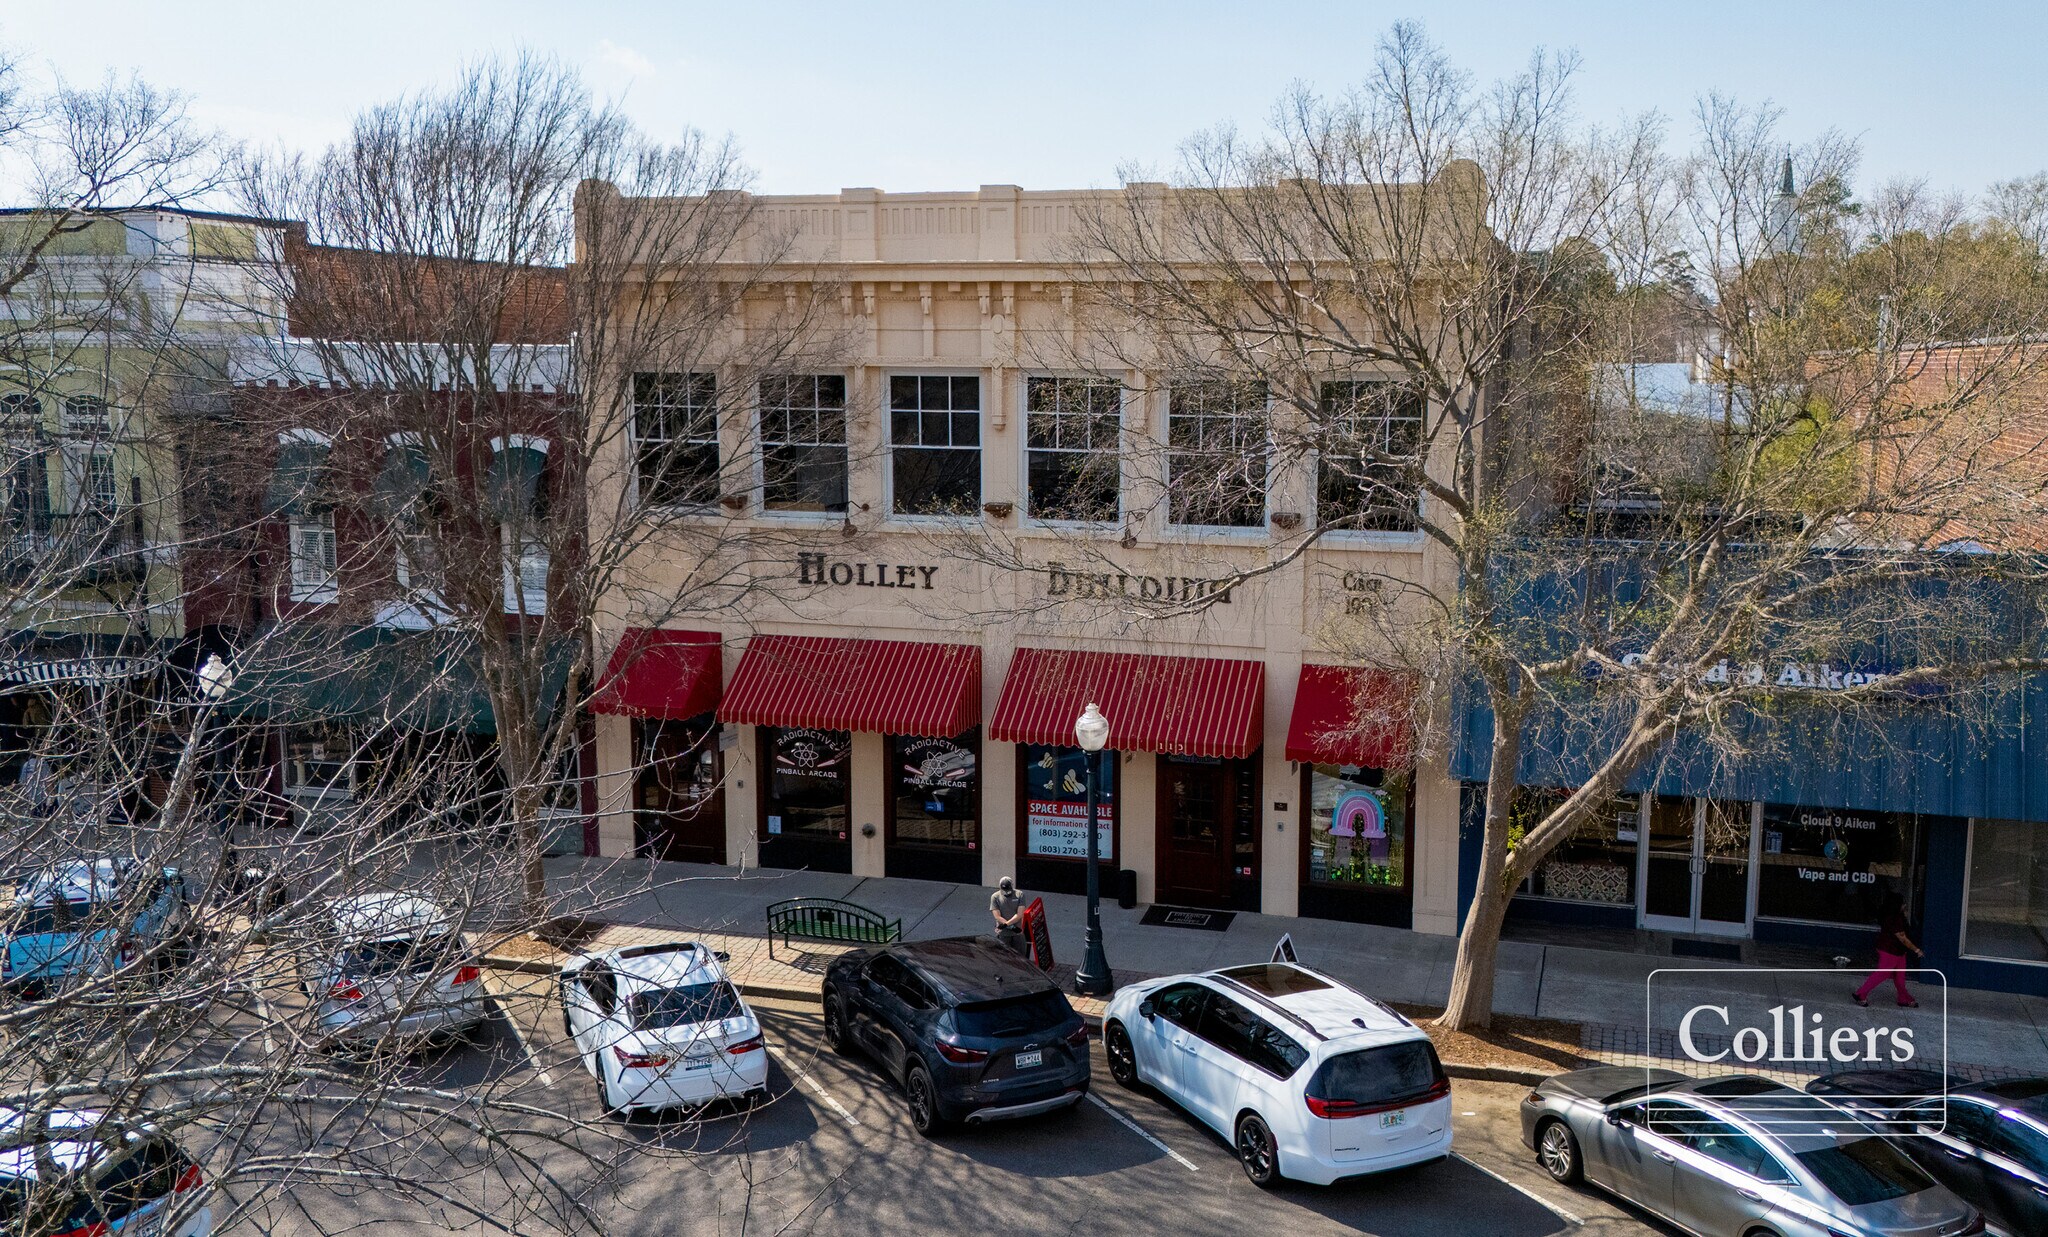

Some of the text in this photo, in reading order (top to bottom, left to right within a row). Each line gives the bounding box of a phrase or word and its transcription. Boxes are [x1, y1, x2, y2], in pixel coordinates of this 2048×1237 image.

[798, 552, 938, 590] HOLLEY
[776, 730, 837, 750] RADIOACTIVE
[904, 738, 966, 760] RADIOACTIVE
[776, 768, 838, 778] PINBALL ARCADE
[903, 777, 967, 788] PINBALL ARCADE
[1030, 803, 1112, 817] SPACE AVAILBLE
[1043, 819, 1084, 829] information
[1800, 814, 1876, 830] Cloud 9 Aiken
[1039, 828, 1102, 840] (803) 292-30
[1039, 845, 1060, 855] (803)
[1798, 867, 1876, 884] Vape and CBD
